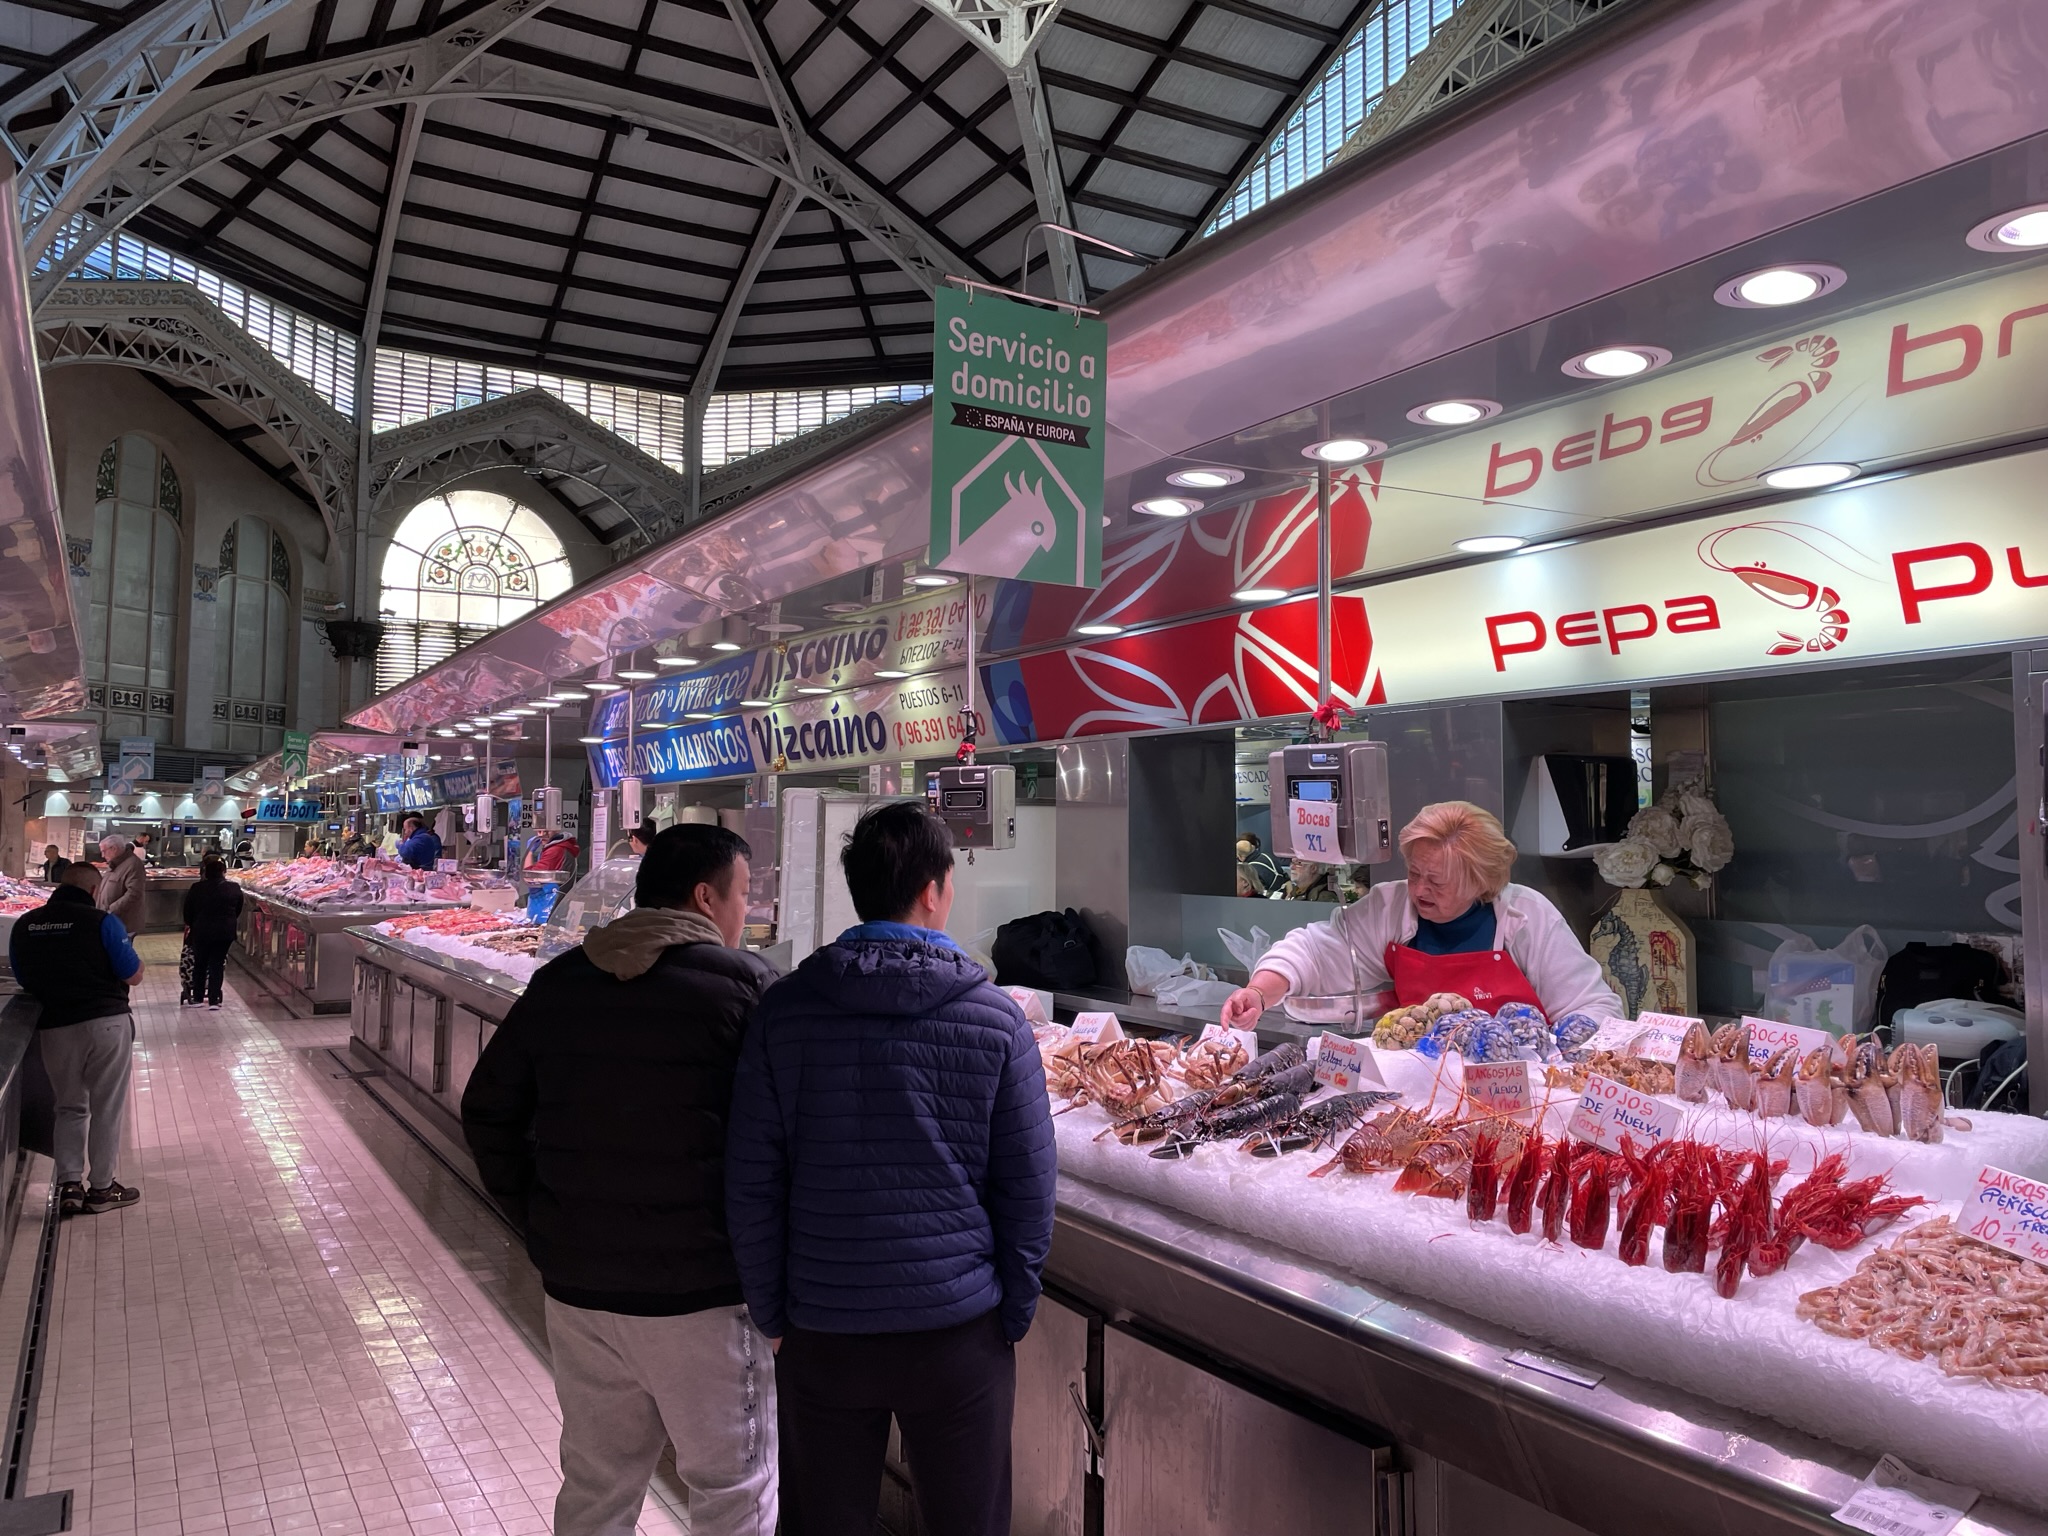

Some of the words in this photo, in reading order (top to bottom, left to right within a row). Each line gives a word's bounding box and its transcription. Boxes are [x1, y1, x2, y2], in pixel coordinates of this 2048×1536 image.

[948, 316, 1071, 375] Servicio
[1079, 354, 1096, 380] a
[951, 360, 1092, 419] domicilio
[984, 413, 1026, 435] ESPAÑA
[1026, 420, 1035, 435] Y
[1035, 422, 1077, 443] EUROPA
[899, 688, 940, 710] PUESTOS
[941, 683, 964, 704] 6-11
[671, 724, 749, 771] MARISCOS
[751, 700, 887, 764] Vizcaíno
[905, 720, 922, 745] 96
[924, 715, 945, 742] 391
[67, 803, 122, 813] ALFREDO
[127, 804, 146, 815] GIL
[1296, 807, 1331, 828] Bocas
[1305, 833, 1327, 853] XL
[1745, 1023, 1799, 1048] BOCAS
[1587, 1076, 1654, 1116] ROJOS
[1574, 1113, 1606, 1137] TODOS
[1580, 1096, 1604, 1114] DE
[1613, 1107, 1662, 1137] HUELVA
[1978, 1168, 2048, 1202] LANGOS
